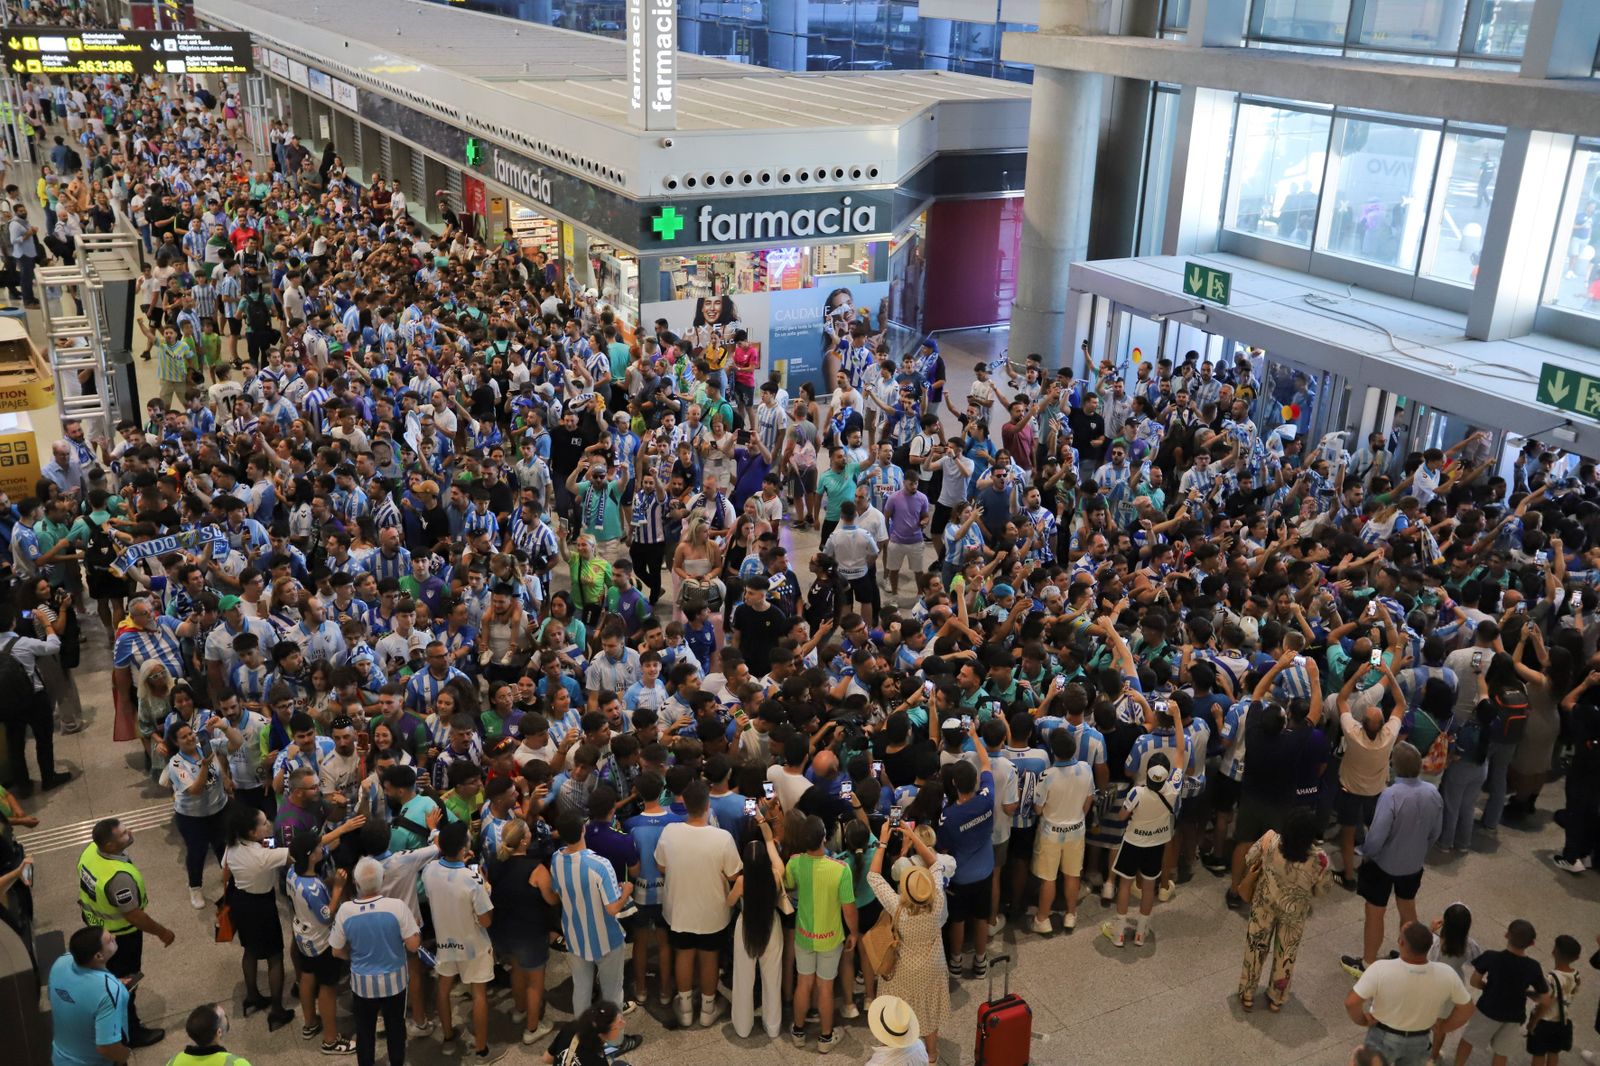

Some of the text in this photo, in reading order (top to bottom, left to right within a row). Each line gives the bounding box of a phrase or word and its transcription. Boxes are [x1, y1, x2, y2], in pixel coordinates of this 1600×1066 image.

[77, 60, 103, 73] 363
[108, 60, 133, 73] 386
[494, 149, 551, 205] farmacia
[699, 196, 876, 242] farmacia
